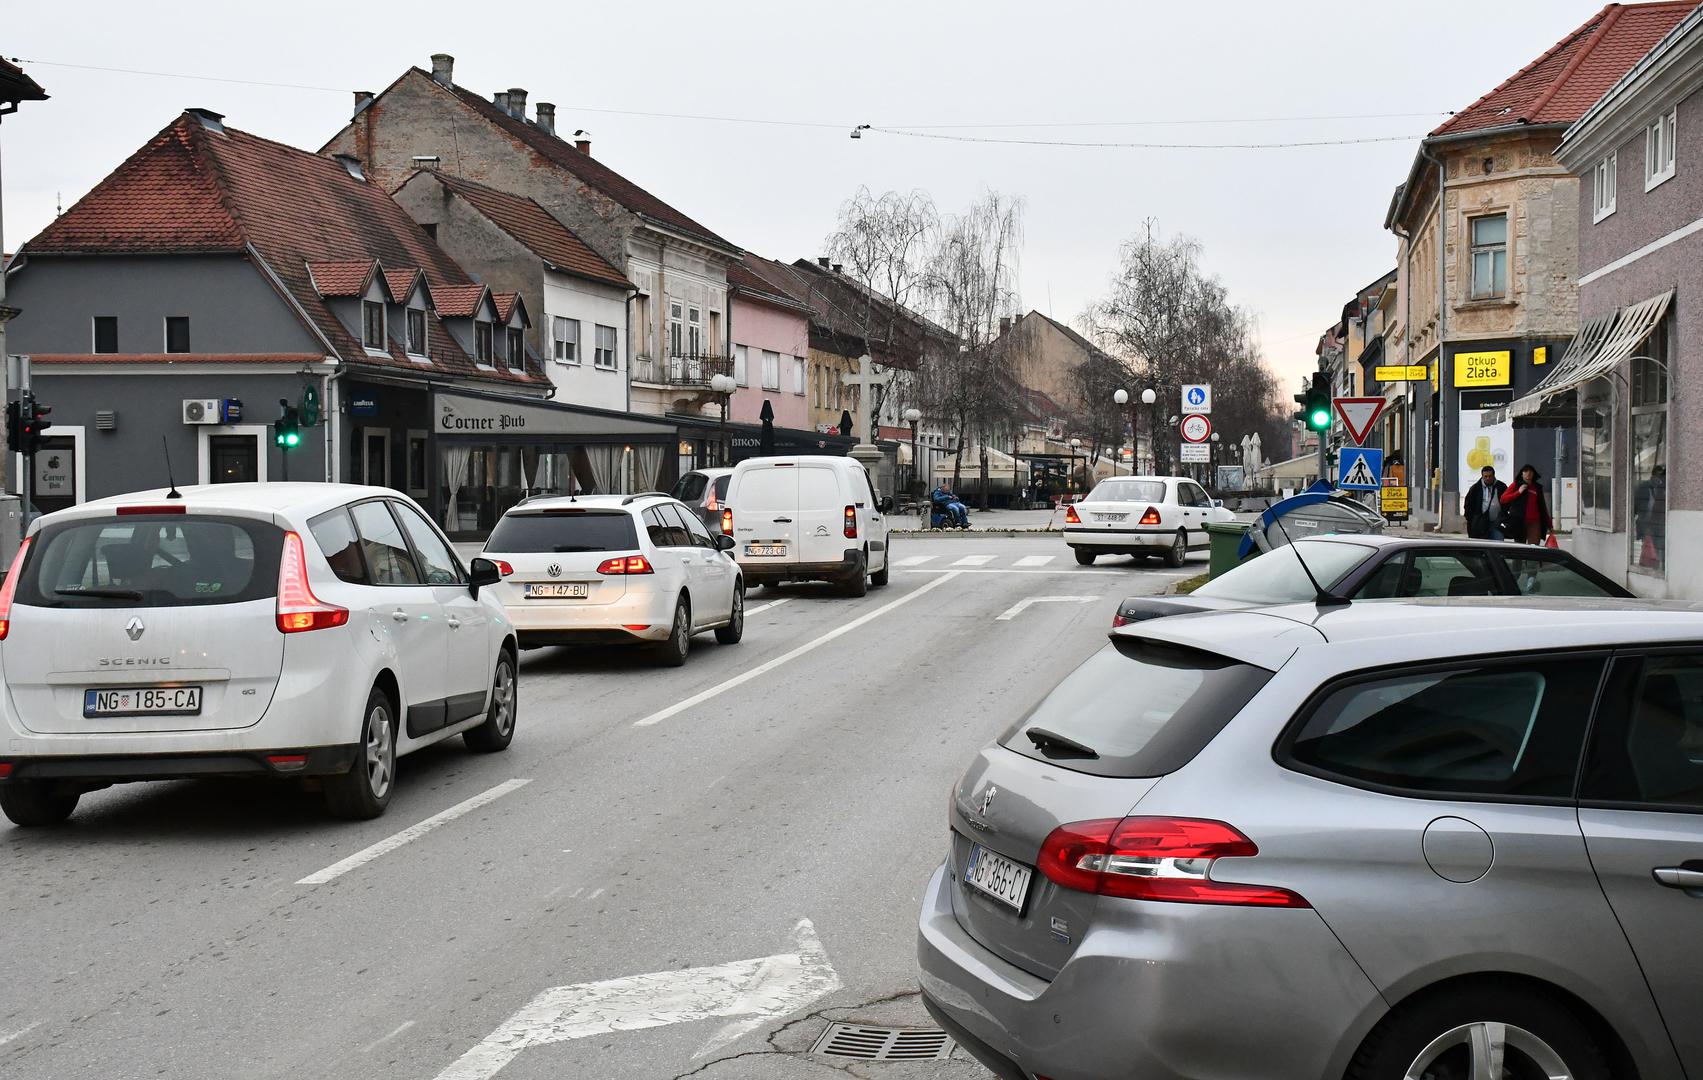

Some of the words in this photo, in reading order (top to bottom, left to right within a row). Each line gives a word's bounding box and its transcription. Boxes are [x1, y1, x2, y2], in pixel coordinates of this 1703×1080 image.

[1467, 357, 1497, 367] Otkup
[1466, 367, 1498, 379] Zlata
[441, 413, 495, 430] Corner
[499, 414, 526, 430] Pub
[42, 474, 66, 482] Corner
[531, 585, 544, 596] NG
[552, 585, 586, 596] 147-BU
[99, 657, 171, 666] SCENIC
[97, 692, 119, 711] NG
[134, 689, 197, 710] 185-CA
[973, 849, 989, 882] NG
